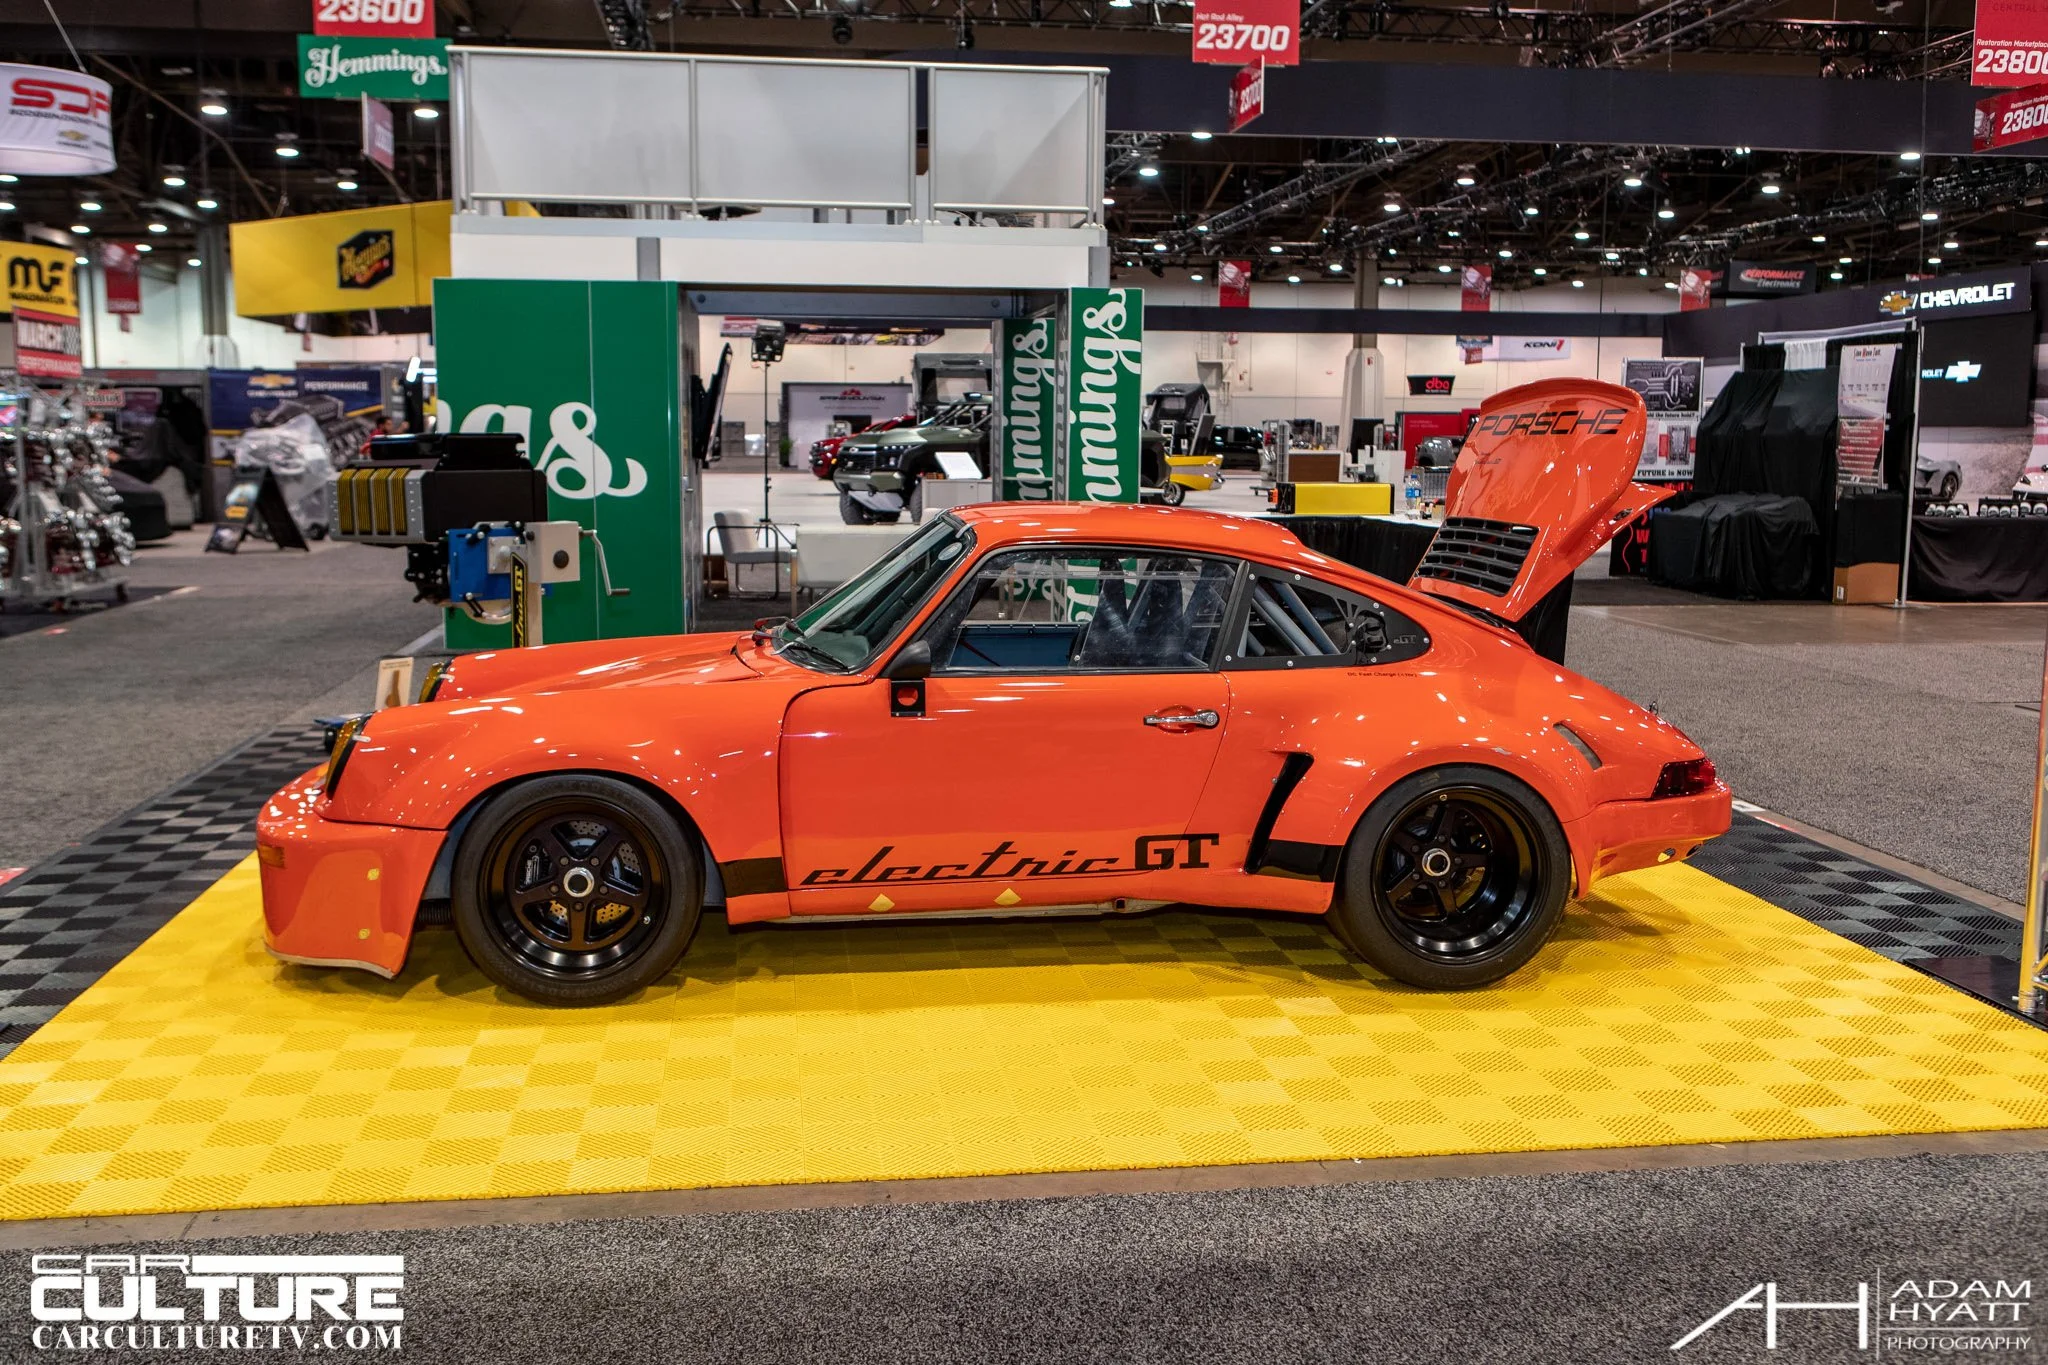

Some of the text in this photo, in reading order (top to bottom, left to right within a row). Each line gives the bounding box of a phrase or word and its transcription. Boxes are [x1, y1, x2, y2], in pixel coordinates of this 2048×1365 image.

[318, 0, 425, 24] 23600
[1196, 13, 1244, 23] Hot Rod Alley
[1196, 23, 1290, 51] 23700
[1976, 38, 2013, 47] Restoration
[1745, 269, 1806, 281] PERFORMANCE
[1757, 279, 1801, 289] Electronics
[1920, 282, 2016, 309] CHEVROLET
[1524, 341, 1557, 349] KONI
[304, 381, 369, 391] PERFORMANCE
[1425, 376, 1450, 390] dba
[1476, 408, 1629, 438] PORSCHE
[1638, 469, 1667, 477] FUTURE
[1677, 469, 1694, 477] NOW
[1394, 635, 1416, 644] eGT
[800, 833, 1219, 887] electric GT
